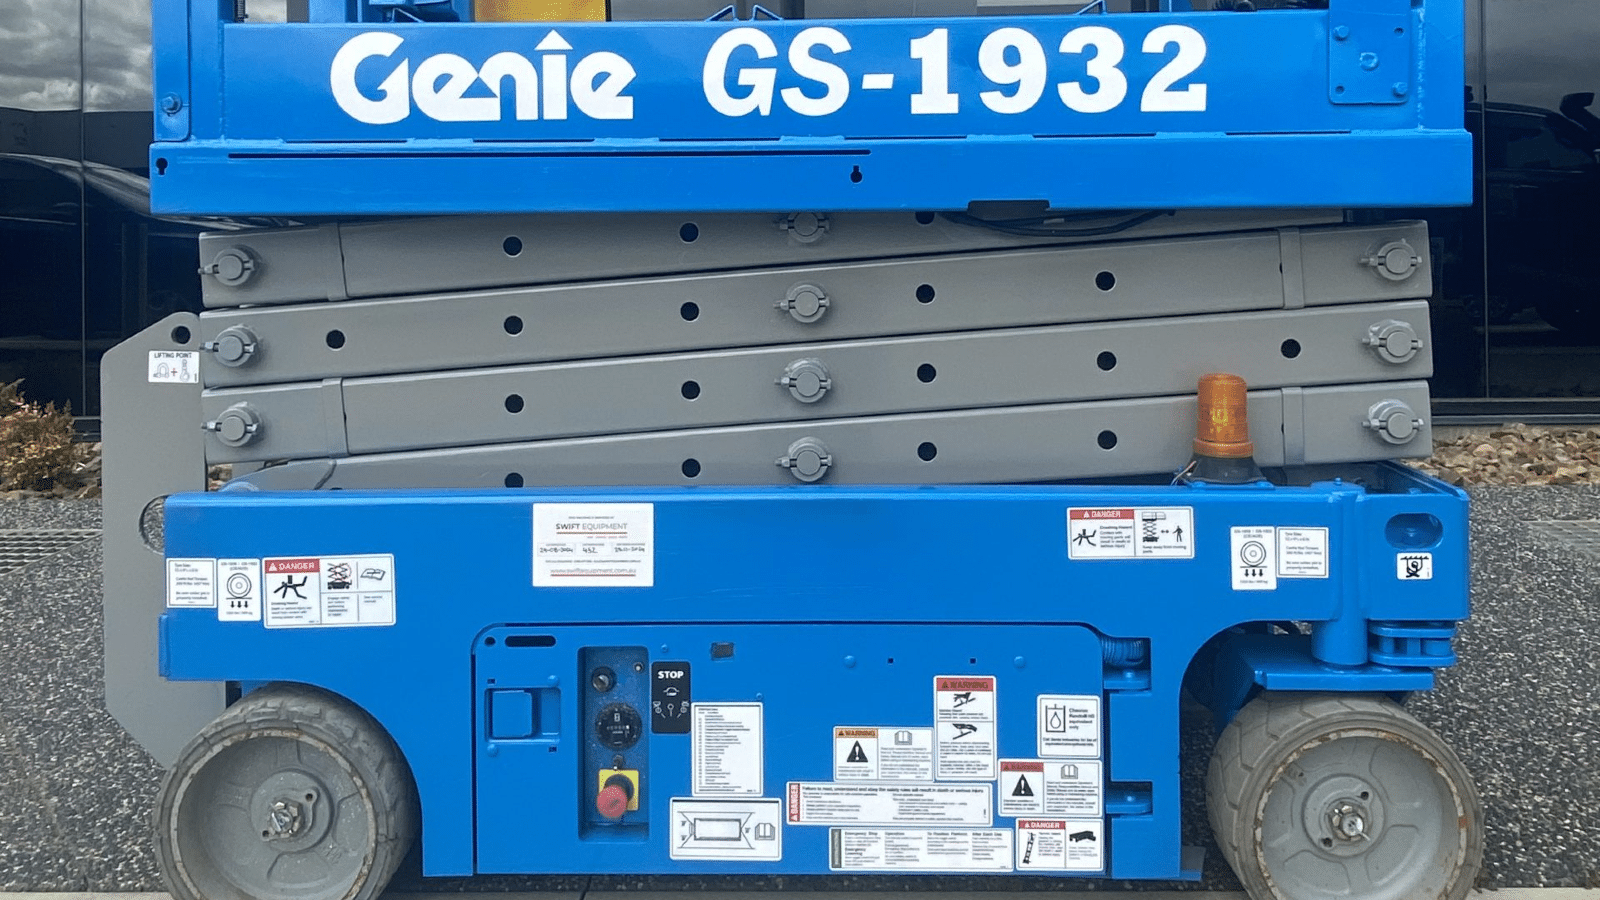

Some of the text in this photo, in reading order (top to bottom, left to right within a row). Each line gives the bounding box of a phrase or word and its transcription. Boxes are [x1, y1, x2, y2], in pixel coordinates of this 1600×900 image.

[330, 24, 1207, 125] Genie GS-1932
[582, 523, 628, 531] EQUIPMENT
[279, 562, 315, 570] DANGER
[657, 670, 684, 679] STOP
[950, 681, 989, 689] WARNING
